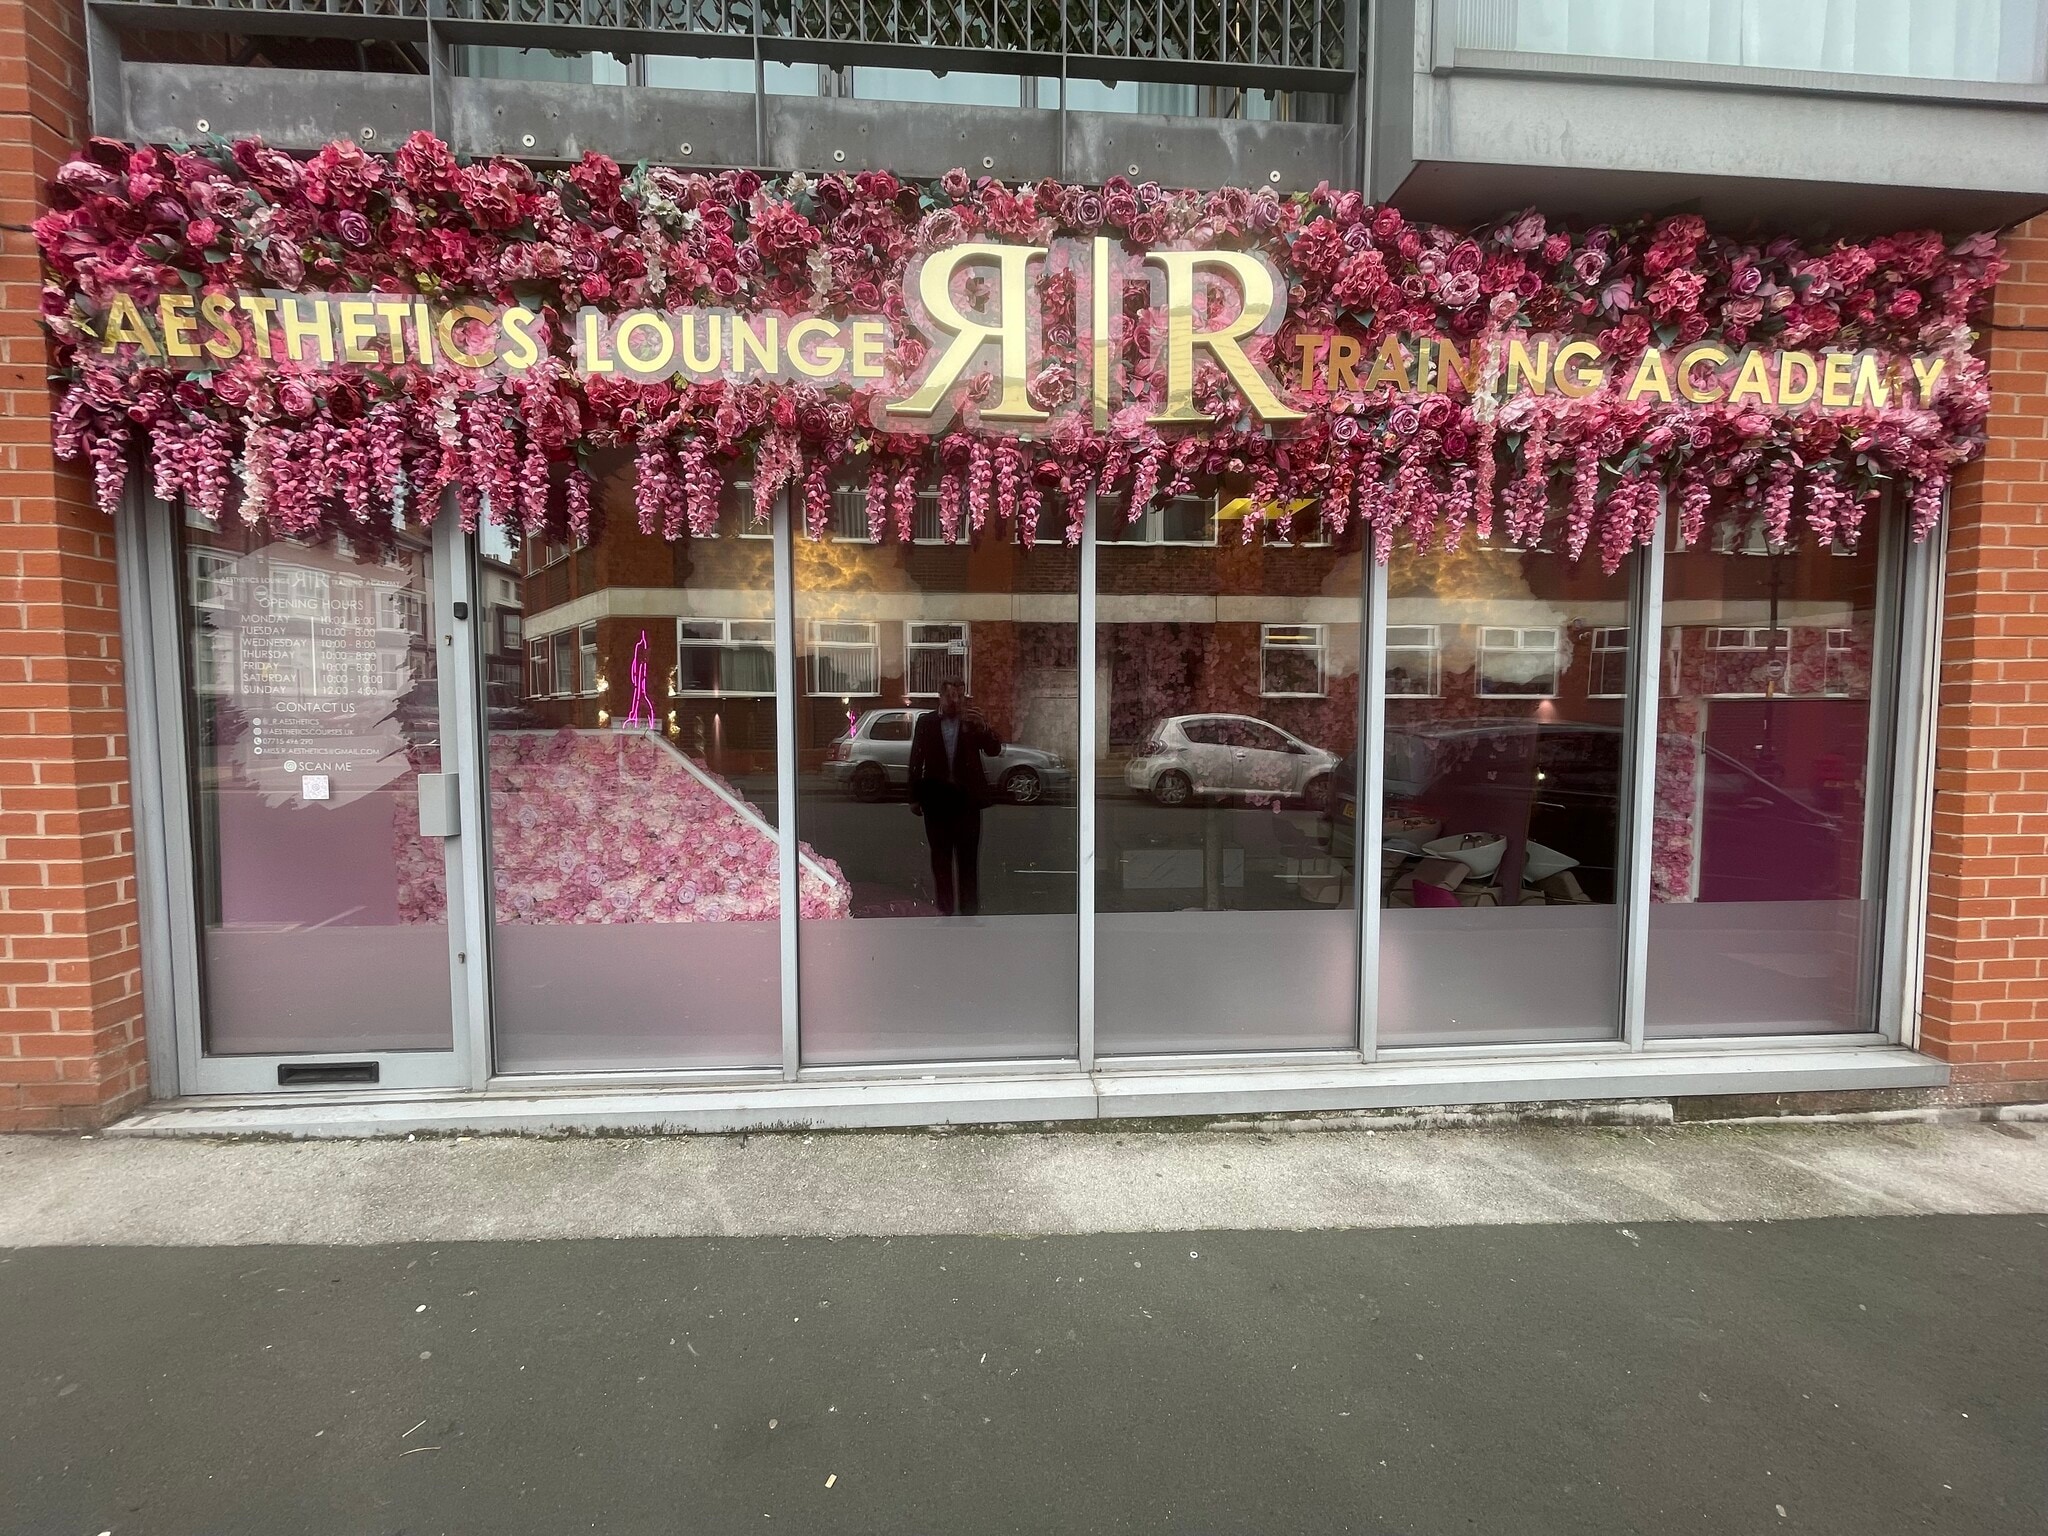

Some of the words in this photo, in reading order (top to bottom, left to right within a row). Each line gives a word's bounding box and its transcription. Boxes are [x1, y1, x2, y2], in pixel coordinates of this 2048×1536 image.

[101, 293, 539, 369] AESTHETICS
[583, 309, 885, 377] LOUNGE
[1627, 347, 1946, 410] ACADEMY
[259, 597, 318, 610] OPENING
[321, 598, 364, 611] HOURS
[241, 614, 290, 623] MONDAY
[320, 616, 346, 625] 10:00
[354, 616, 375, 626] 8:00
[241, 626, 286, 635] TUESDAY
[321, 627, 346, 637] 10:00
[355, 628, 376, 638] 8:00
[242, 638, 307, 647] WEDNESDAY
[321, 639, 347, 648] 10:00
[355, 640, 376, 649] 8:00
[242, 650, 295, 659] THURSDAY
[321, 651, 347, 660] 10:00
[355, 652, 376, 661] 8:00
[243, 661, 279, 670] FRIDAY
[322, 663, 348, 672] 10:00
[356, 663, 377, 672] 8:00
[243, 673, 297, 683] SATURDAY
[322, 674, 348, 683] 10:00
[357, 675, 383, 684] 10:00
[243, 685, 286, 694] SUNDAY
[322, 686, 348, 695] 12:00
[357, 687, 378, 695] 4:00
[276, 702, 336, 713] CONTACT
[341, 703, 355, 713] US
[298, 761, 332, 771] SCAN
[335, 762, 352, 772] ME
